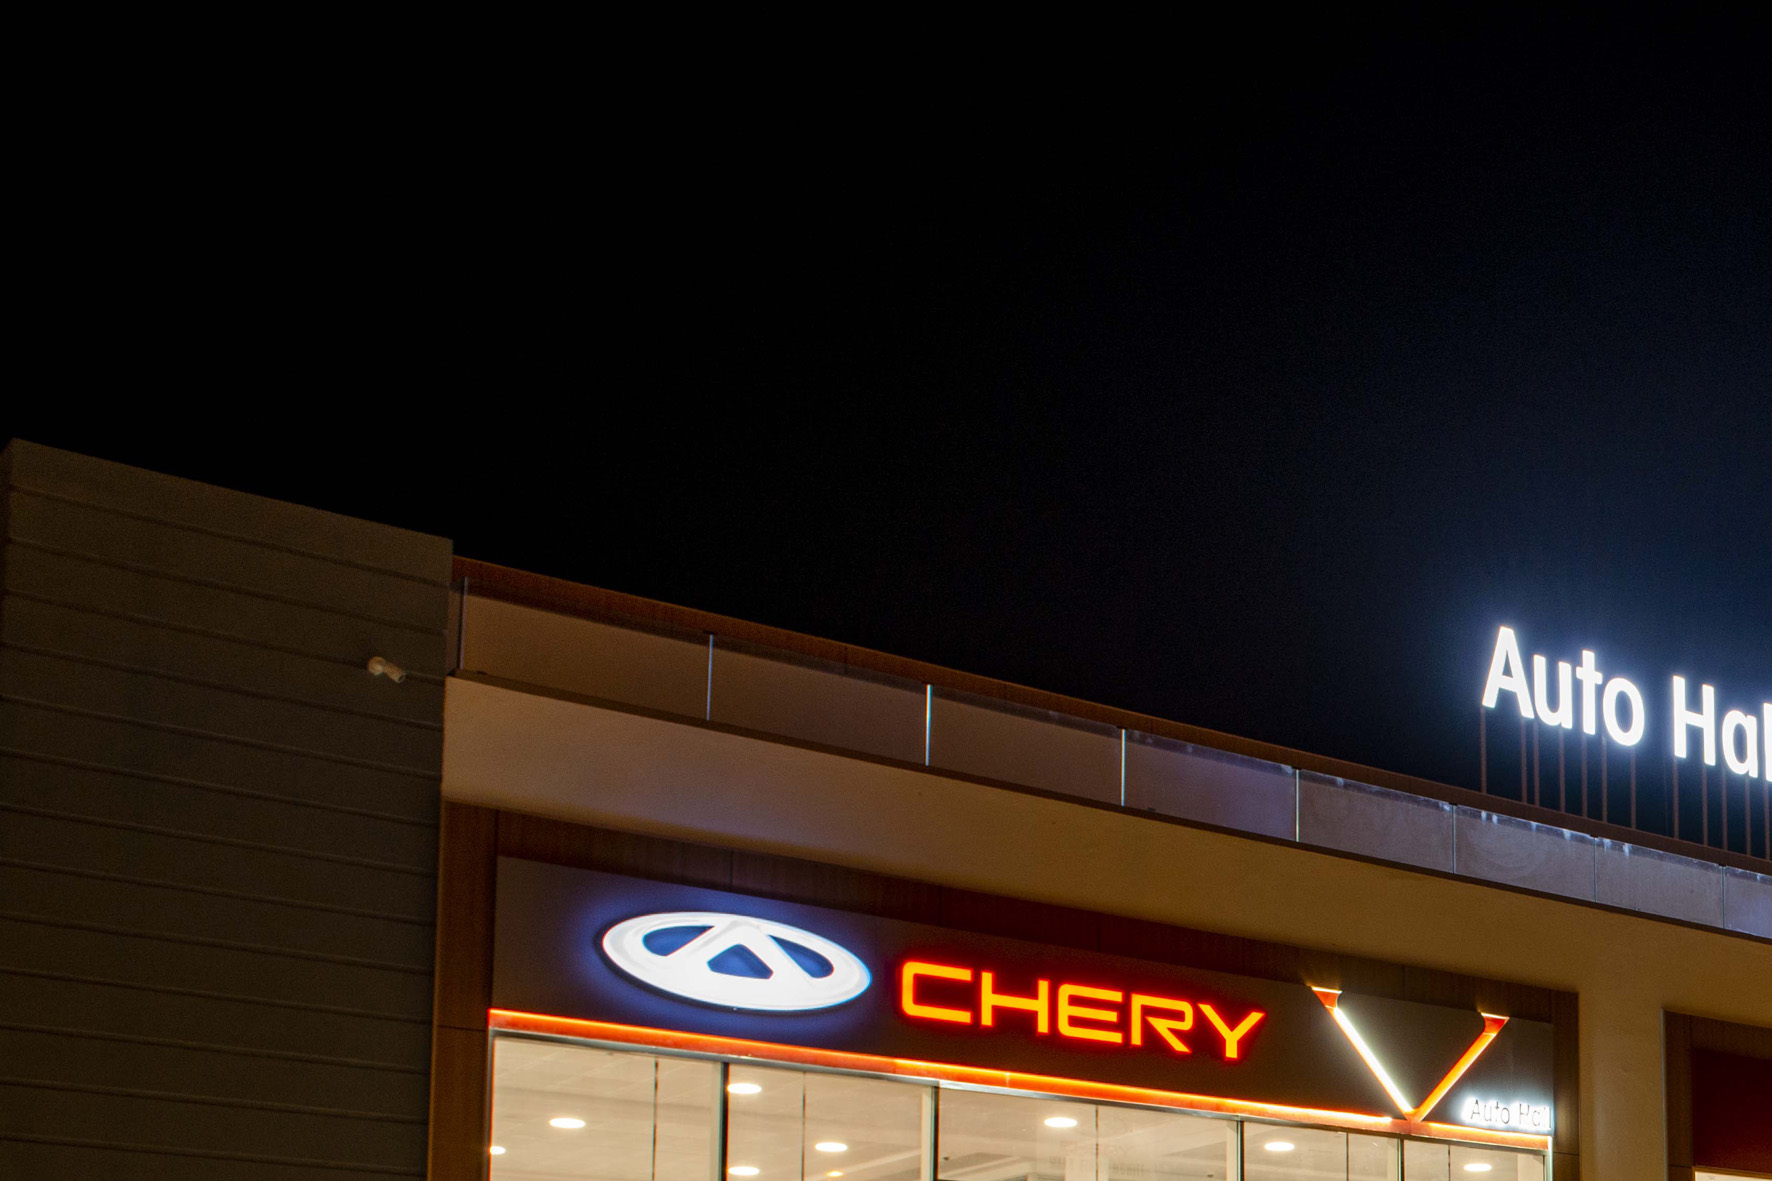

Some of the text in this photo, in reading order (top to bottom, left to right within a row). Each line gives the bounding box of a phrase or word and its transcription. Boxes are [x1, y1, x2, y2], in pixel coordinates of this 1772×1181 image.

[1482, 626, 1645, 747] Auto
[900, 960, 1265, 1059] CHERY
[1470, 1099, 1552, 1129] Auto Hall
